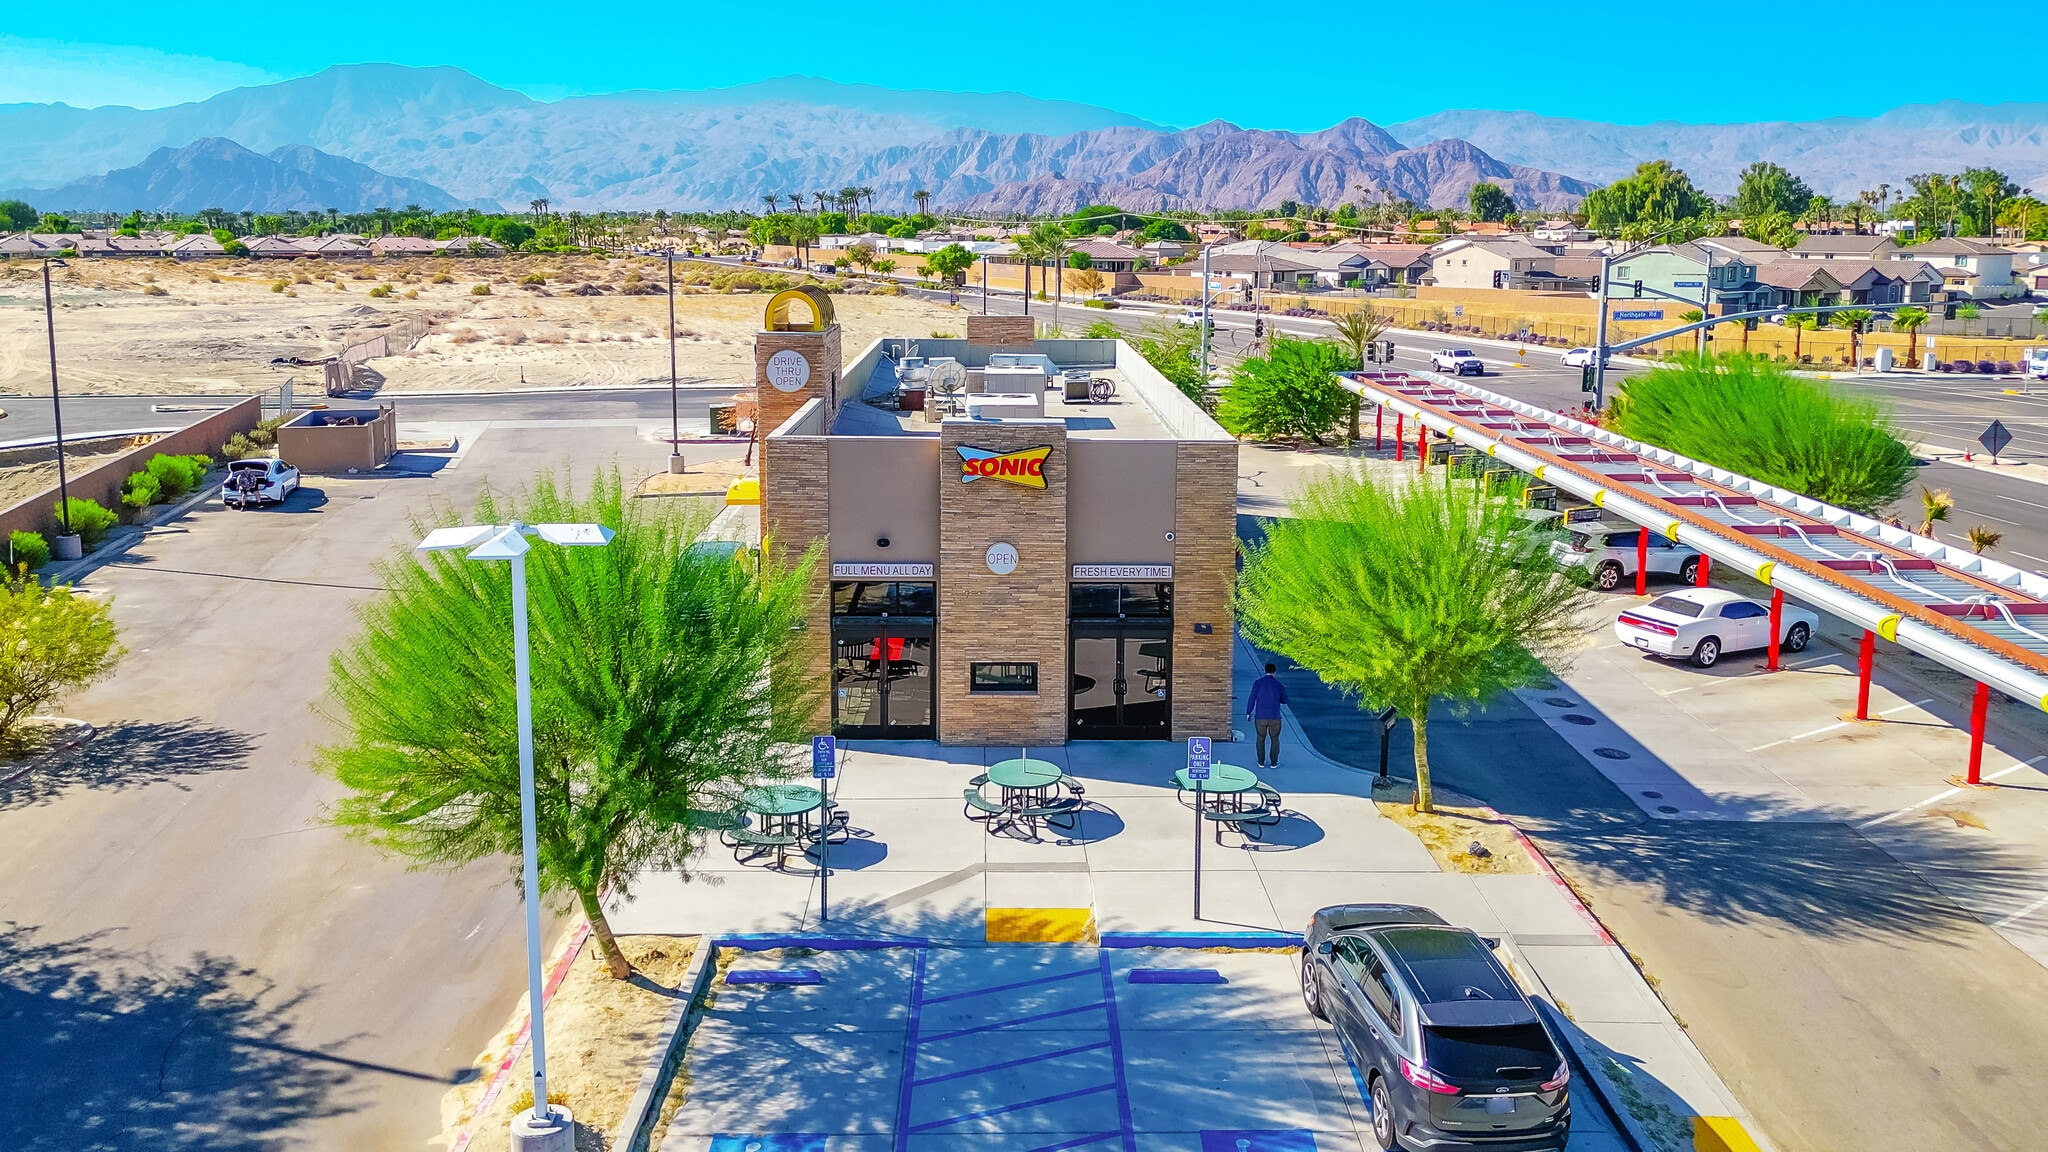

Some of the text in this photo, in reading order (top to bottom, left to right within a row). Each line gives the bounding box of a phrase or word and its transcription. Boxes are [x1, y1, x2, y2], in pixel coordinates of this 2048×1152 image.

[773, 356, 802, 366] DRIVE
[775, 366, 802, 376] THRU
[775, 376, 802, 386] OPEN
[966, 457, 1045, 477] SONIC
[987, 553, 1017, 565] OPEN
[834, 565, 932, 576] FULL MENU ALL DAY
[1074, 566, 1171, 577] FRESH EVERY TIME!
